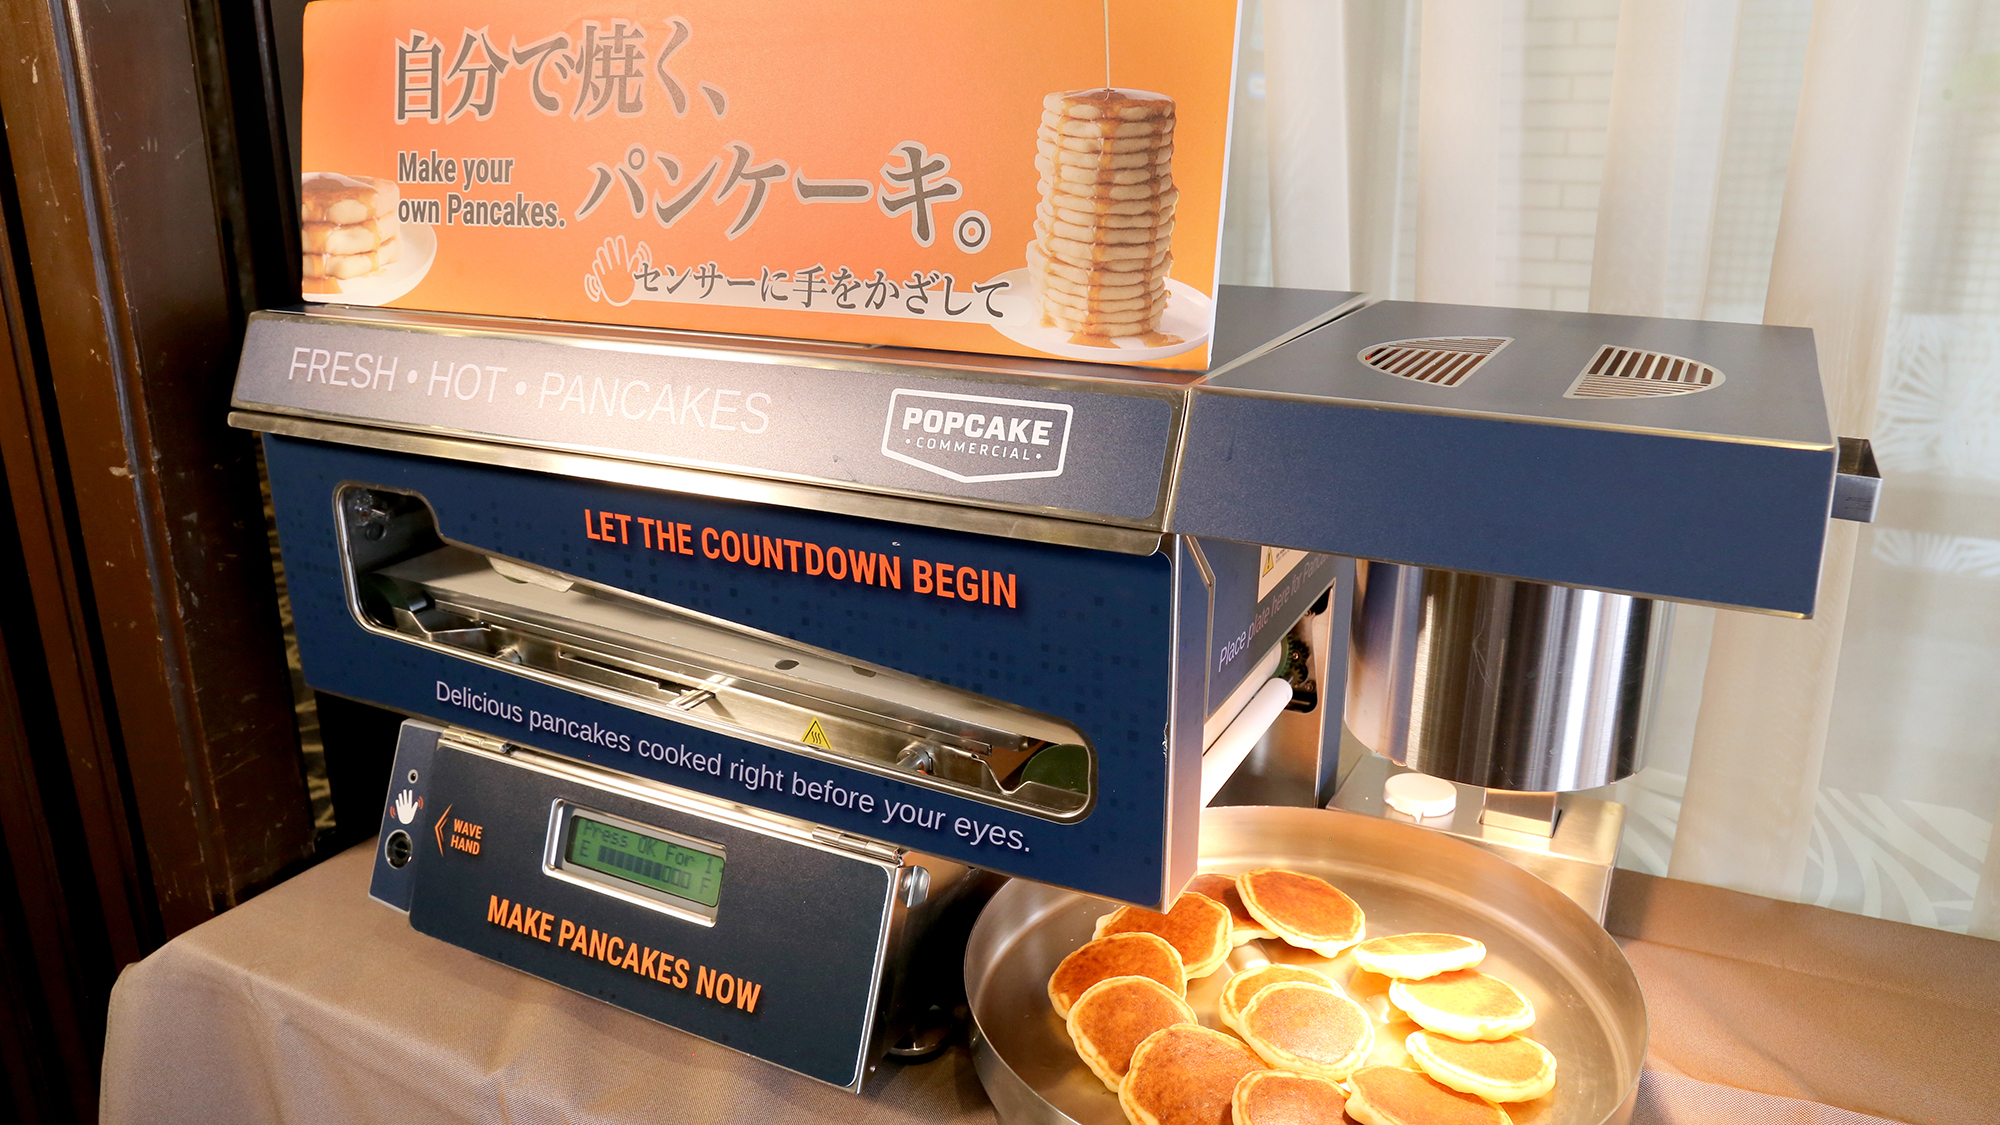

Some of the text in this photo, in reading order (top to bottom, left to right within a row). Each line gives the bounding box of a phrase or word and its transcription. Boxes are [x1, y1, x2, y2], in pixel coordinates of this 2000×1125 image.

[397, 19, 727, 120] 自分で焼く、
[397, 151, 514, 191] Make your
[397, 194, 566, 228] own Pancakes.
[577, 143, 986, 249] パンケーキ。
[633, 262, 1011, 318] センサーに手をかざして
[288, 346, 773, 435] FRESH HOT PANCAKES
[902, 406, 1054, 446] POPCAKE
[915, 436, 1031, 461] COMMERCIAL
[584, 508, 1017, 609] LET THE COUNTDOWN BEGIN
[1218, 631, 1246, 673] Place
[1247, 606, 1270, 649] plate
[1270, 585, 1291, 618] here
[1291, 573, 1303, 598] for
[436, 680, 1031, 853] Delicious pancakes cooked right before your eyes.
[450, 834, 481, 856] HAND
[453, 818, 483, 840] WAVE
[579, 839, 591, 858] E
[583, 819, 629, 849] Press
[637, 835, 659, 858] OK
[665, 843, 696, 868] For
[699, 876, 712, 895] F
[486, 894, 762, 1014] MAKE PANCAKES NOW
